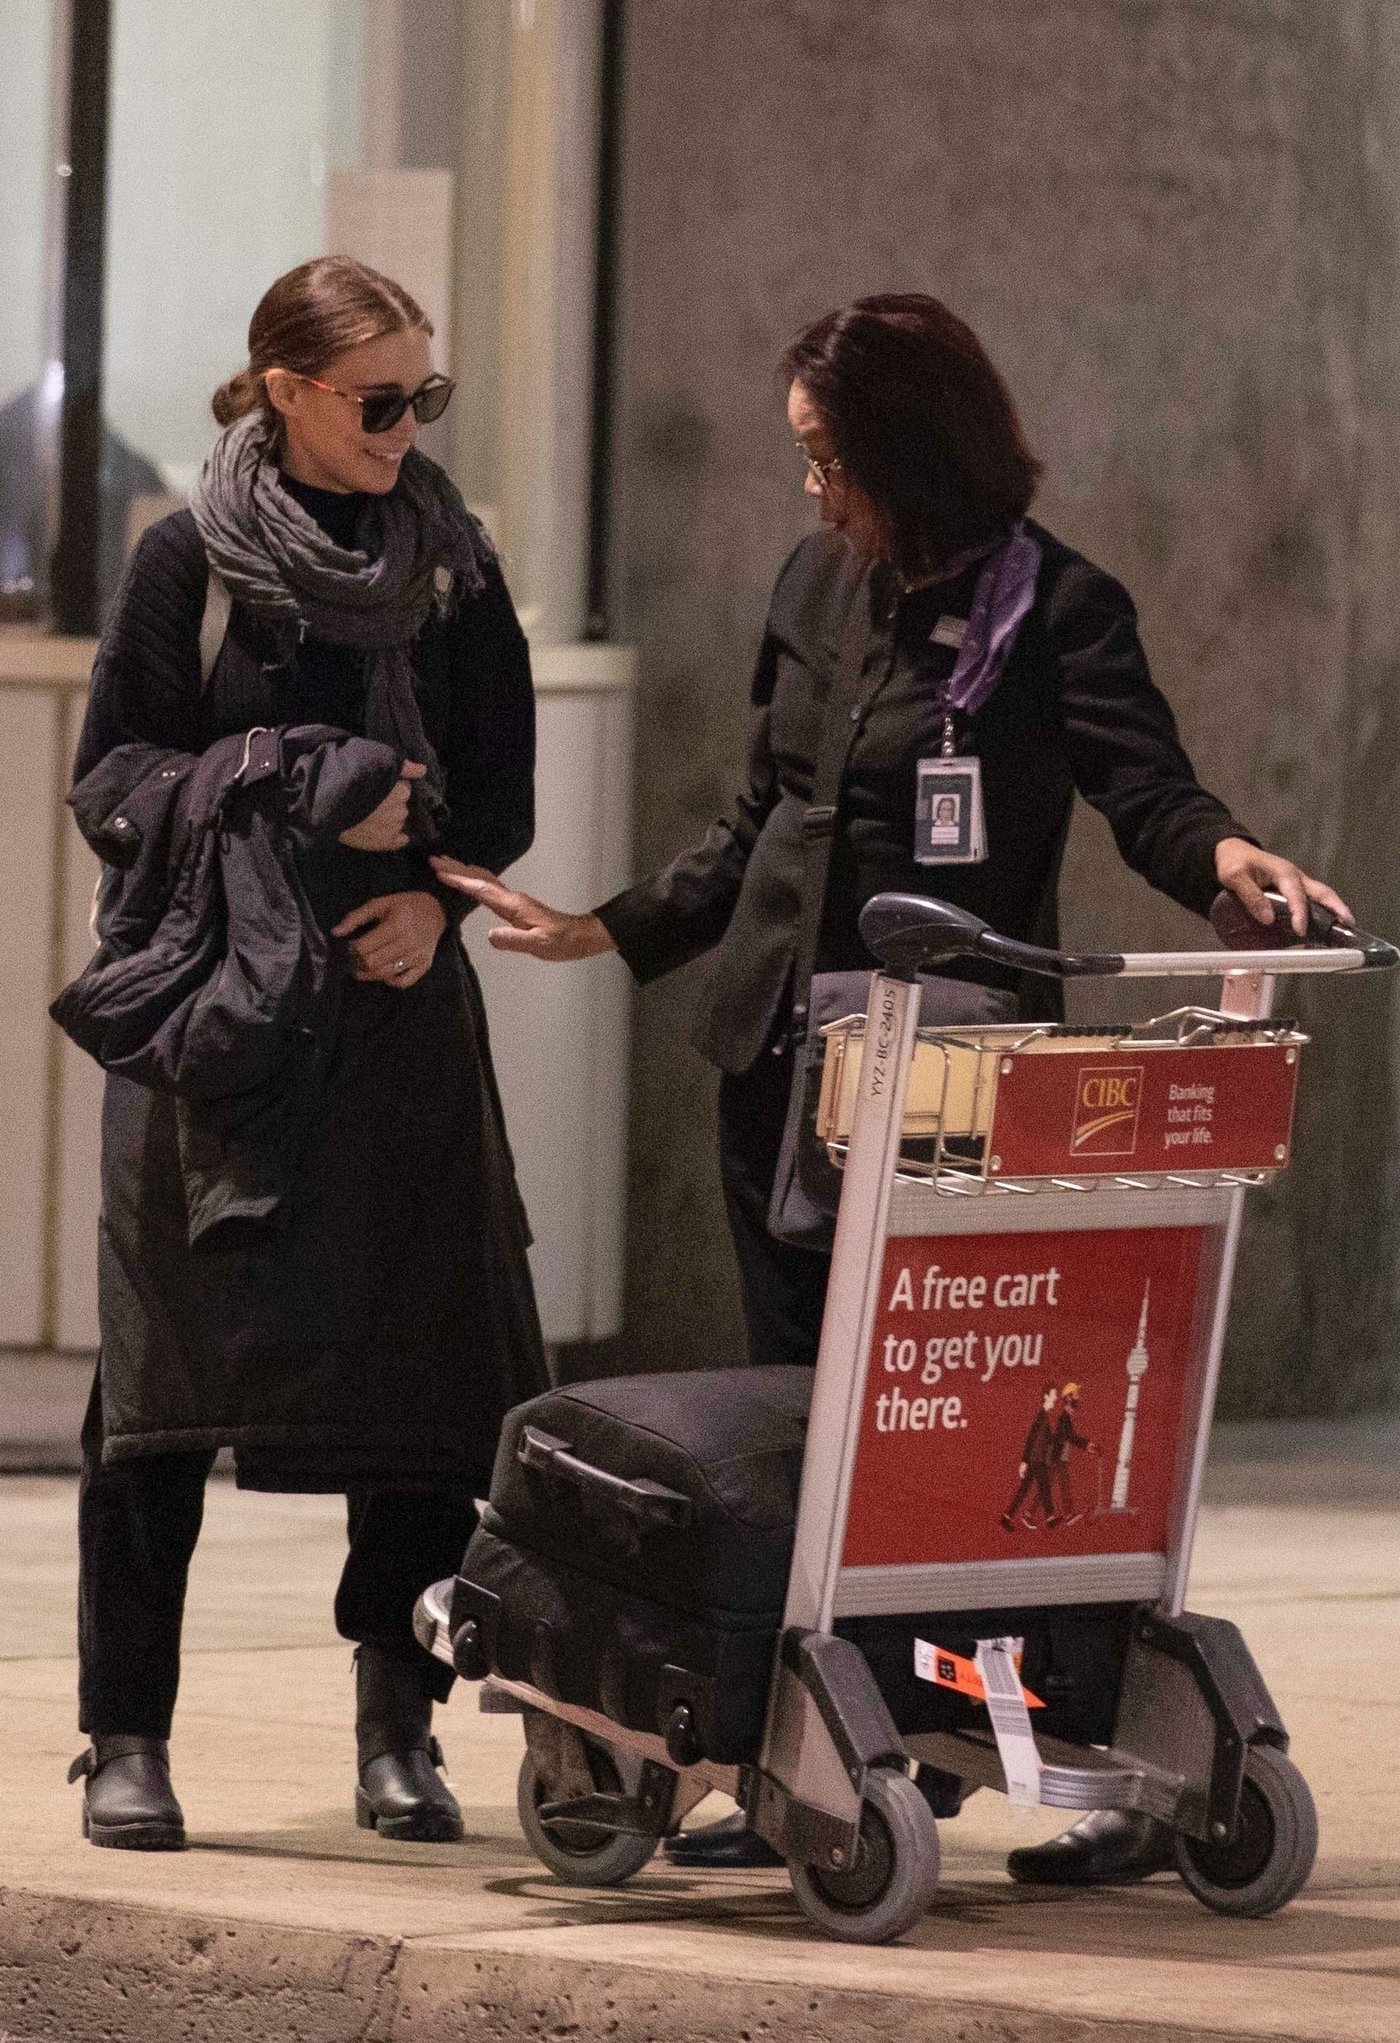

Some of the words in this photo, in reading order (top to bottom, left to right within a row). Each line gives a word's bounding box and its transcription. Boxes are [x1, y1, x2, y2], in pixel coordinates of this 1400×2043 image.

[871, 988, 896, 1096] YYZ-BC-2405
[1083, 1077, 1137, 1107] CIBC
[1168, 1084, 1215, 1104] Banking
[1167, 1106, 1191, 1123] that
[1193, 1105, 1213, 1122] fits
[1164, 1131, 1192, 1149] your
[889, 1267, 914, 1312] A
[922, 1265, 987, 1310] free
[993, 1267, 1061, 1307] cart
[883, 1333, 917, 1372] to
[920, 1330, 978, 1385] get
[981, 1333, 1044, 1382] you
[875, 1386, 968, 1432] there.
